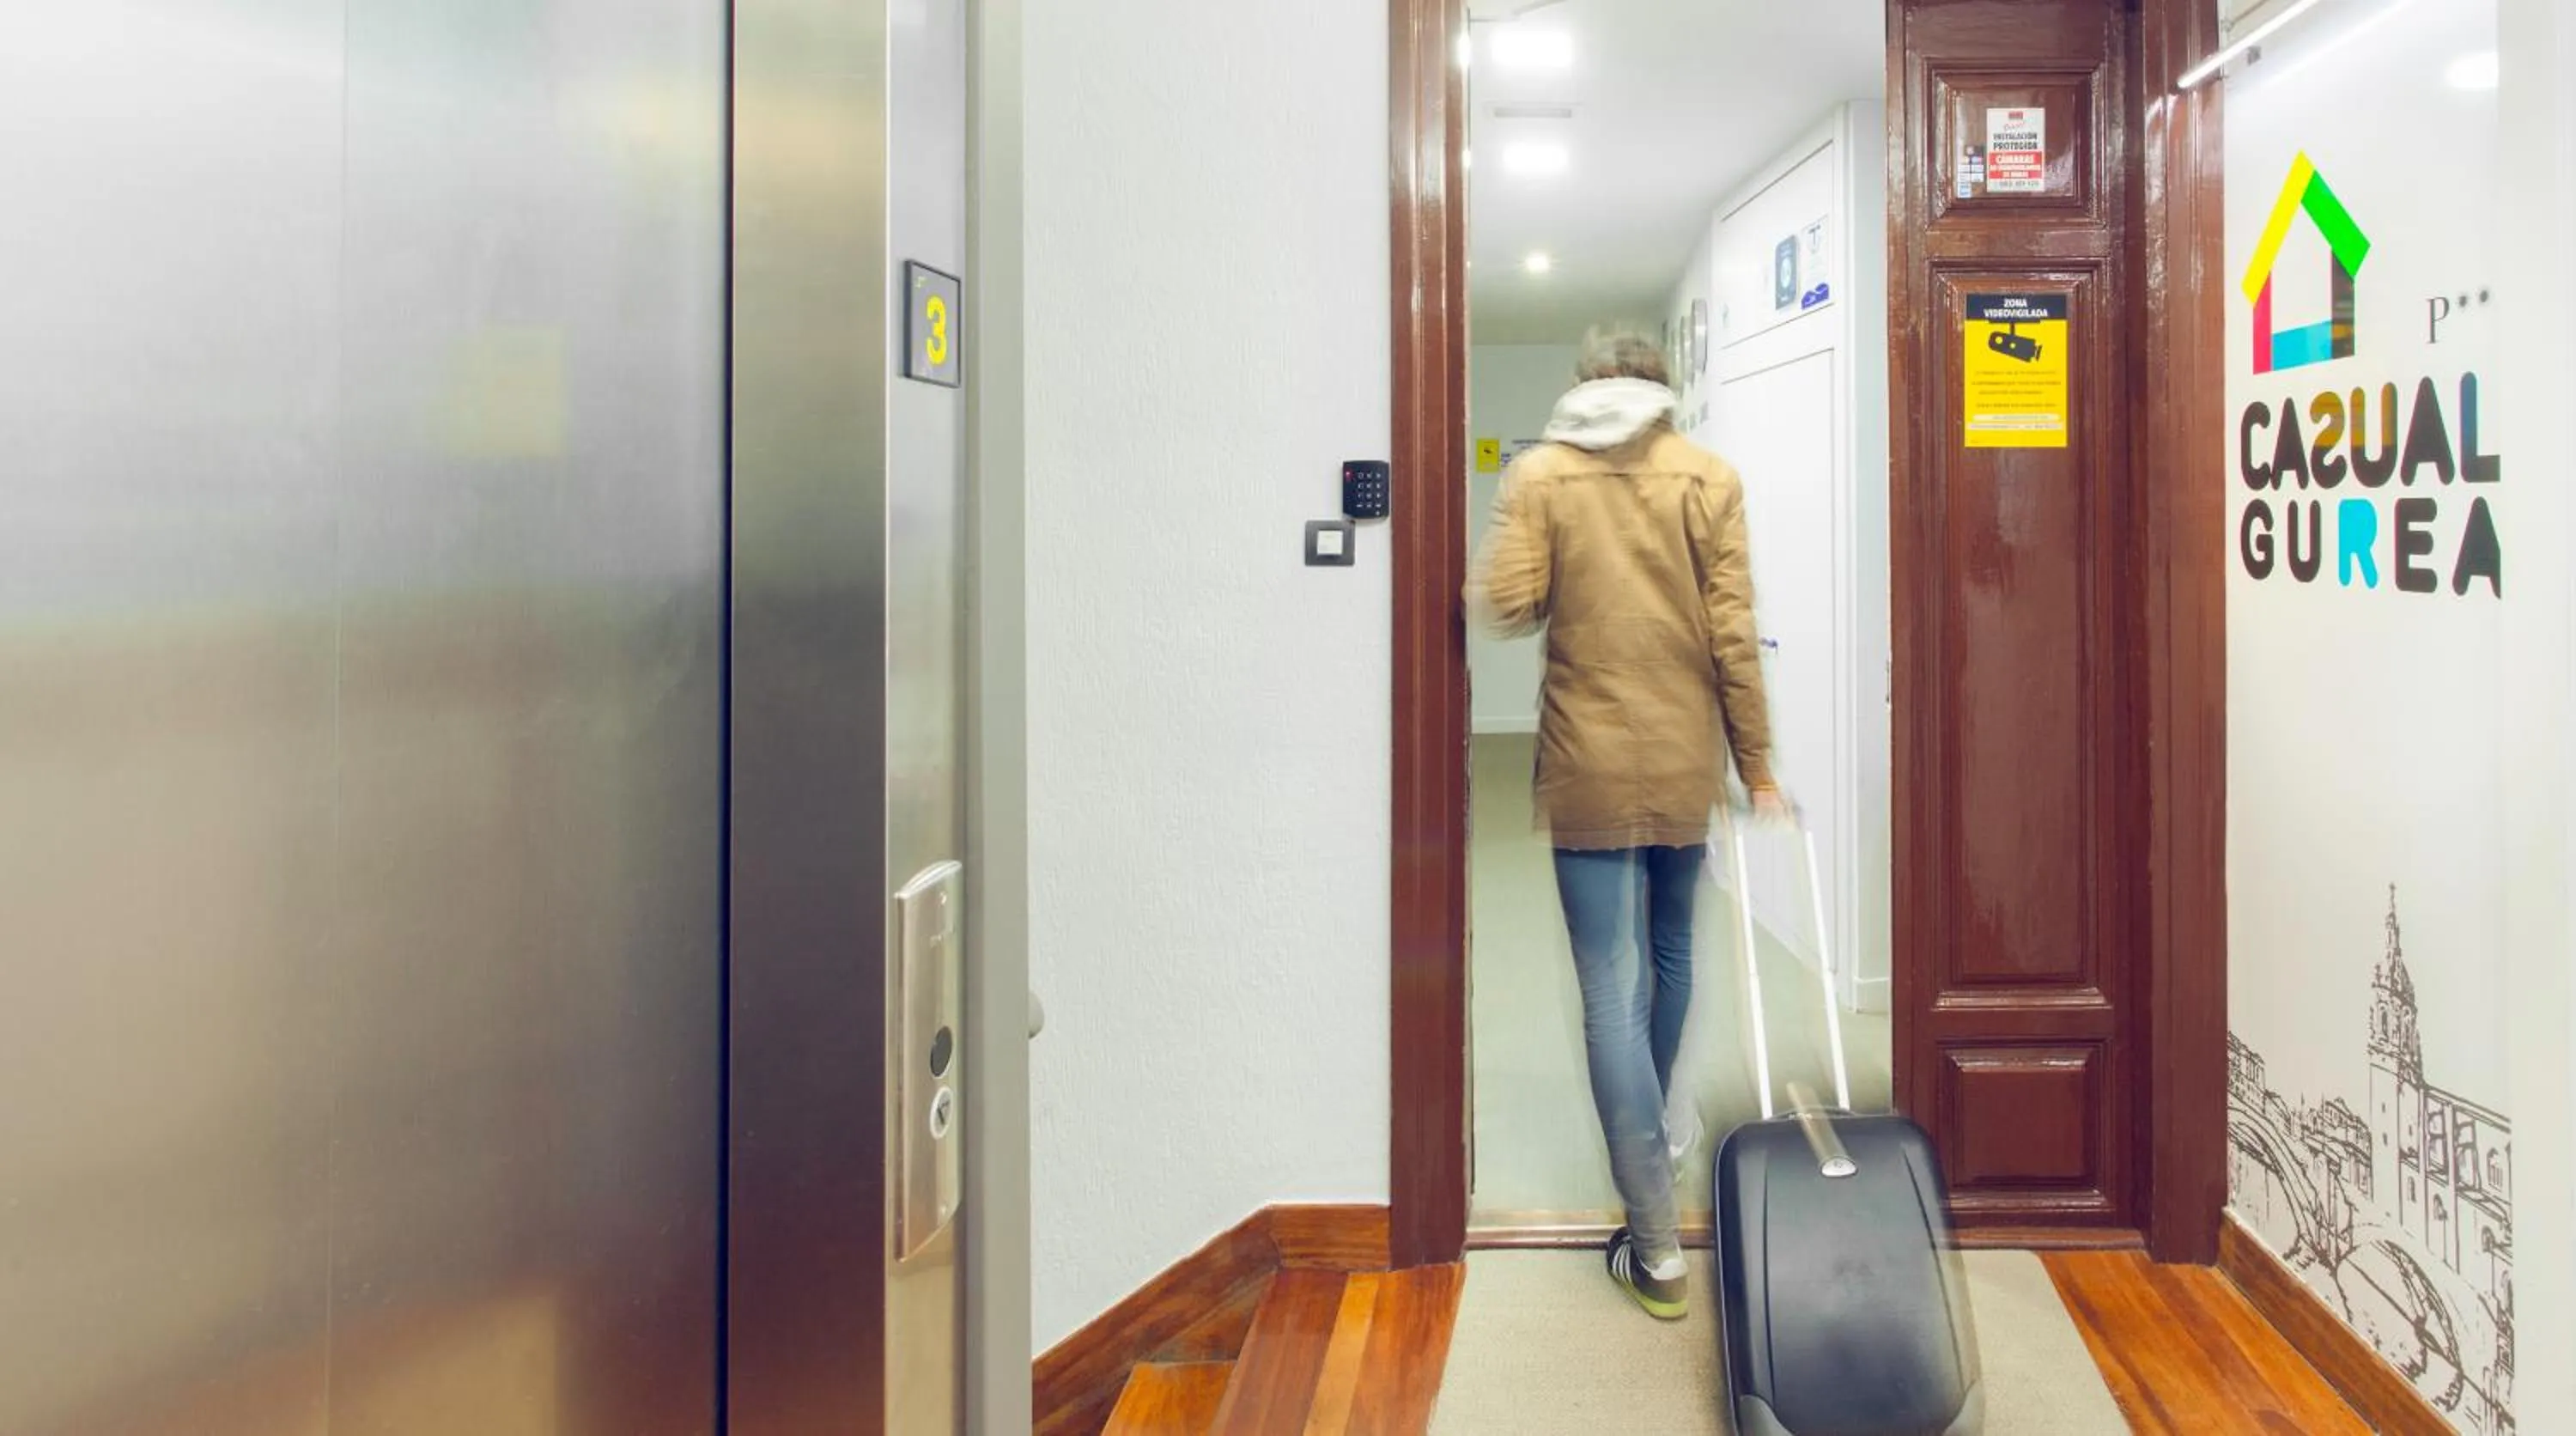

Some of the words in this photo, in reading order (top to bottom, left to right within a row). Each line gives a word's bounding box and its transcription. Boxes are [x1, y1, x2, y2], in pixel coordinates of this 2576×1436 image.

[927, 295, 947, 365] 3
[1984, 308, 2049, 318] VIDEOVIGILADA
[2003, 298, 2027, 307] ZONA
[2240, 371, 2501, 491] CASUAL
[2240, 496, 2501, 599] GUREA
